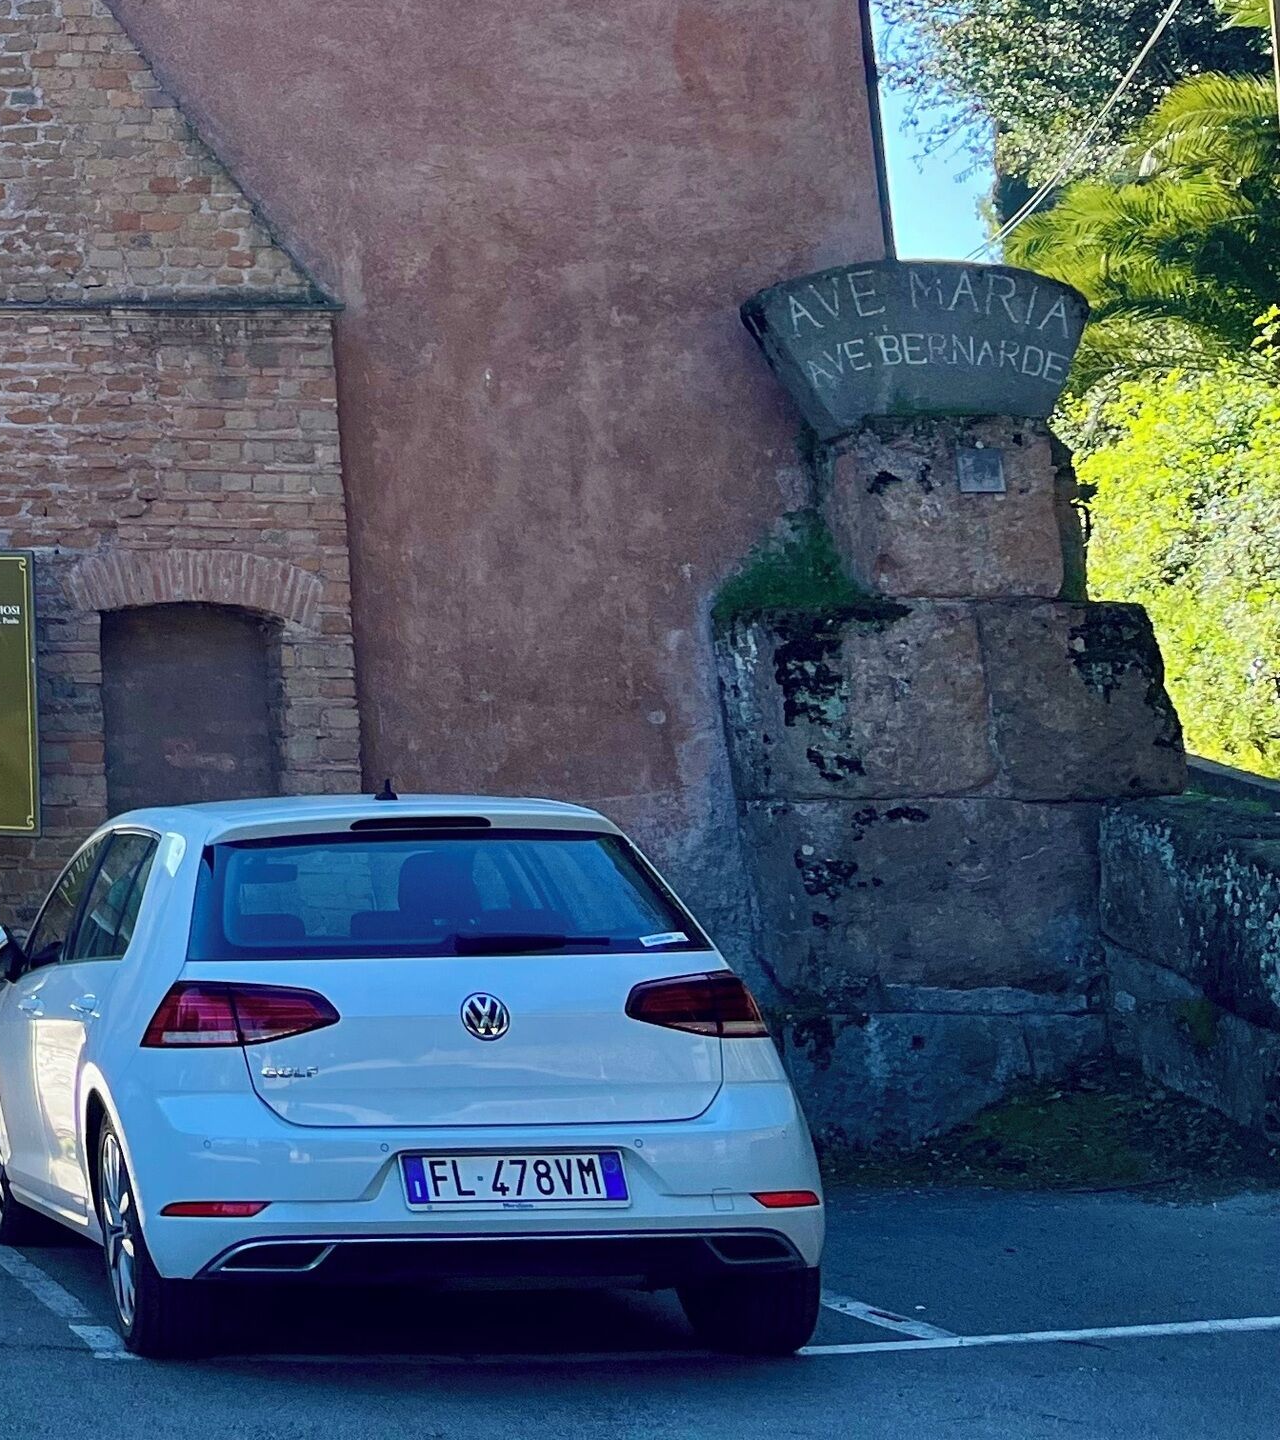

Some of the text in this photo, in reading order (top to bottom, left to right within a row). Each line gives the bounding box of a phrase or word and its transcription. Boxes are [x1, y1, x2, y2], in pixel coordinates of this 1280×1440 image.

[787, 269, 1070, 339] AVE MARIA
[807, 333, 1070, 389] AVE BERNARDE
